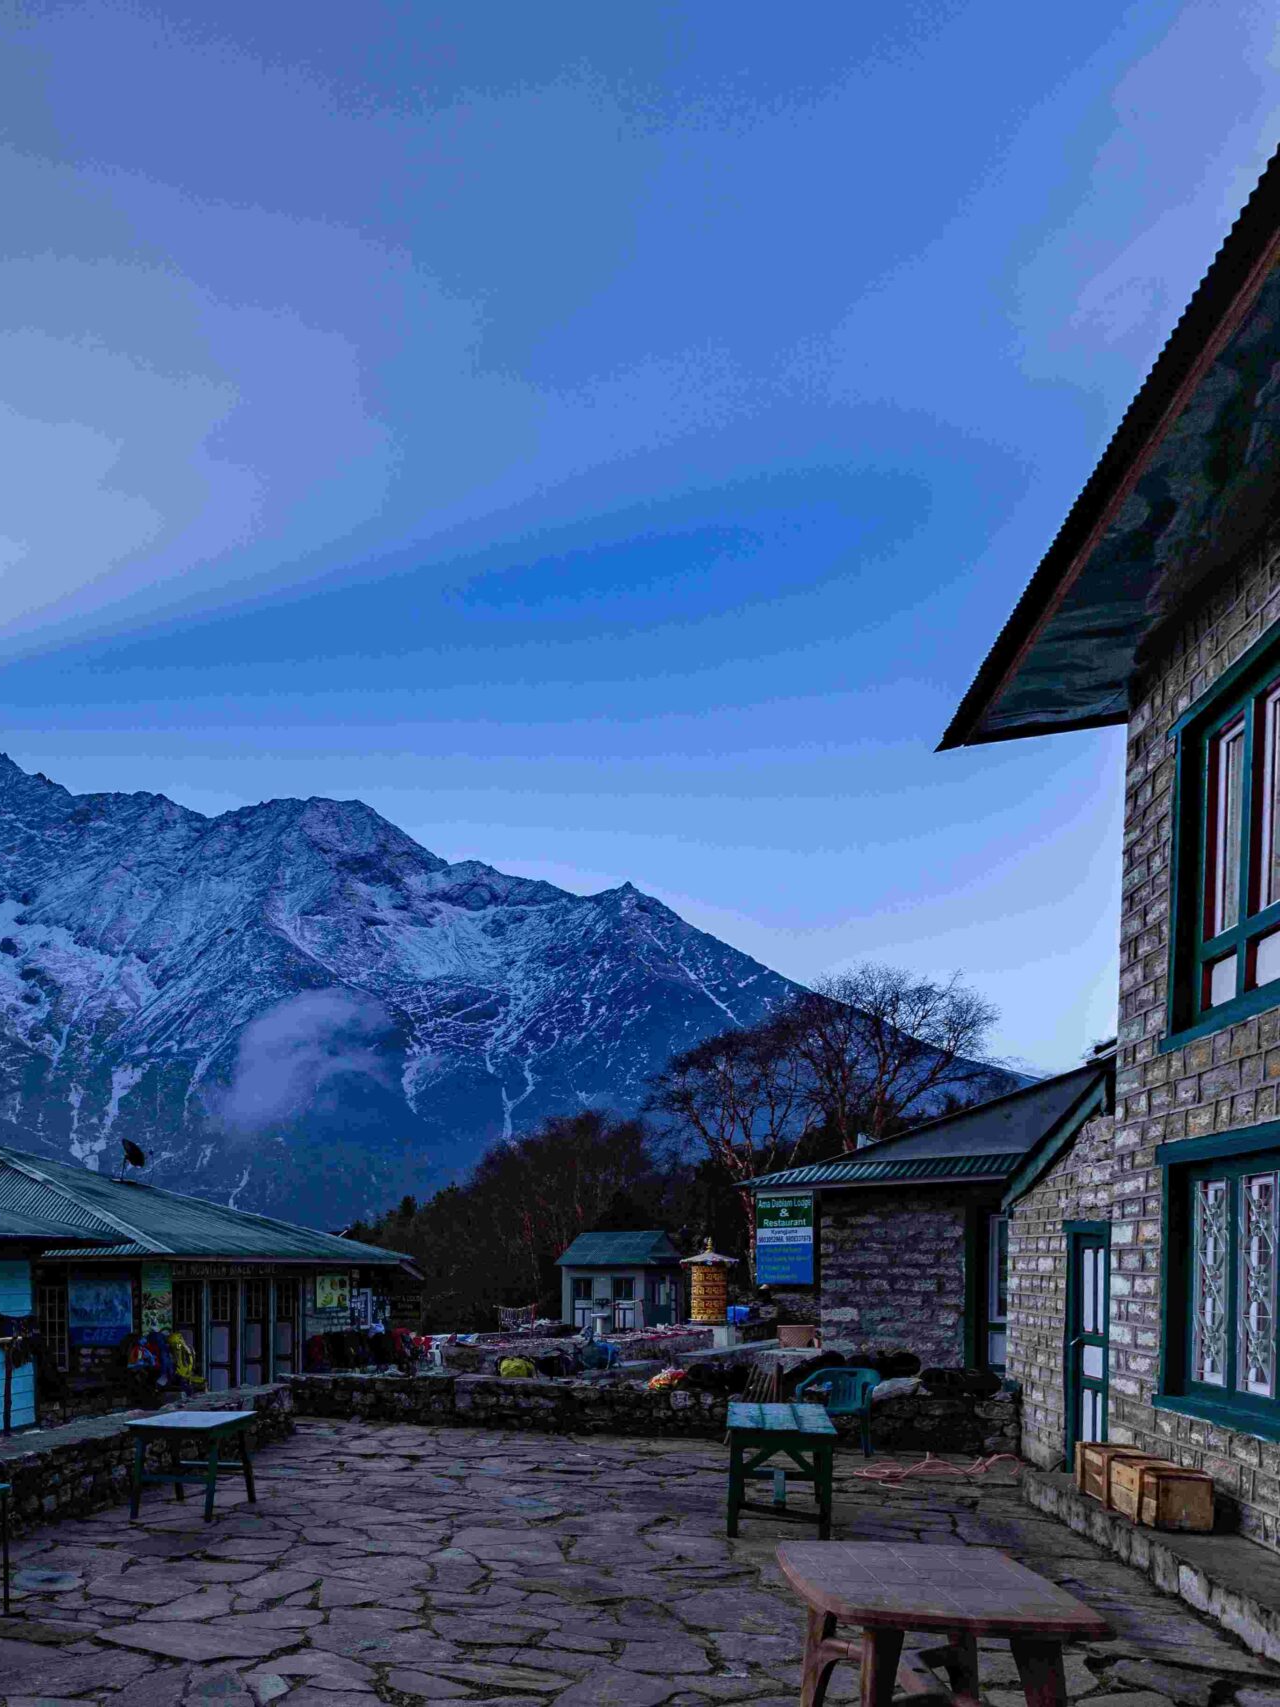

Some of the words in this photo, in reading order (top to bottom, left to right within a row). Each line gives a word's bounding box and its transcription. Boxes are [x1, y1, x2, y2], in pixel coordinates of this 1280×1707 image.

[758, 1200, 771, 1209] Ama
[772, 1198, 793, 1208] Dablam
[794, 1198, 812, 1209] Lodge
[779, 1208, 789, 1217] &
[763, 1218, 806, 1227] Restaurant
[83, 1328, 118, 1341] CAFE
